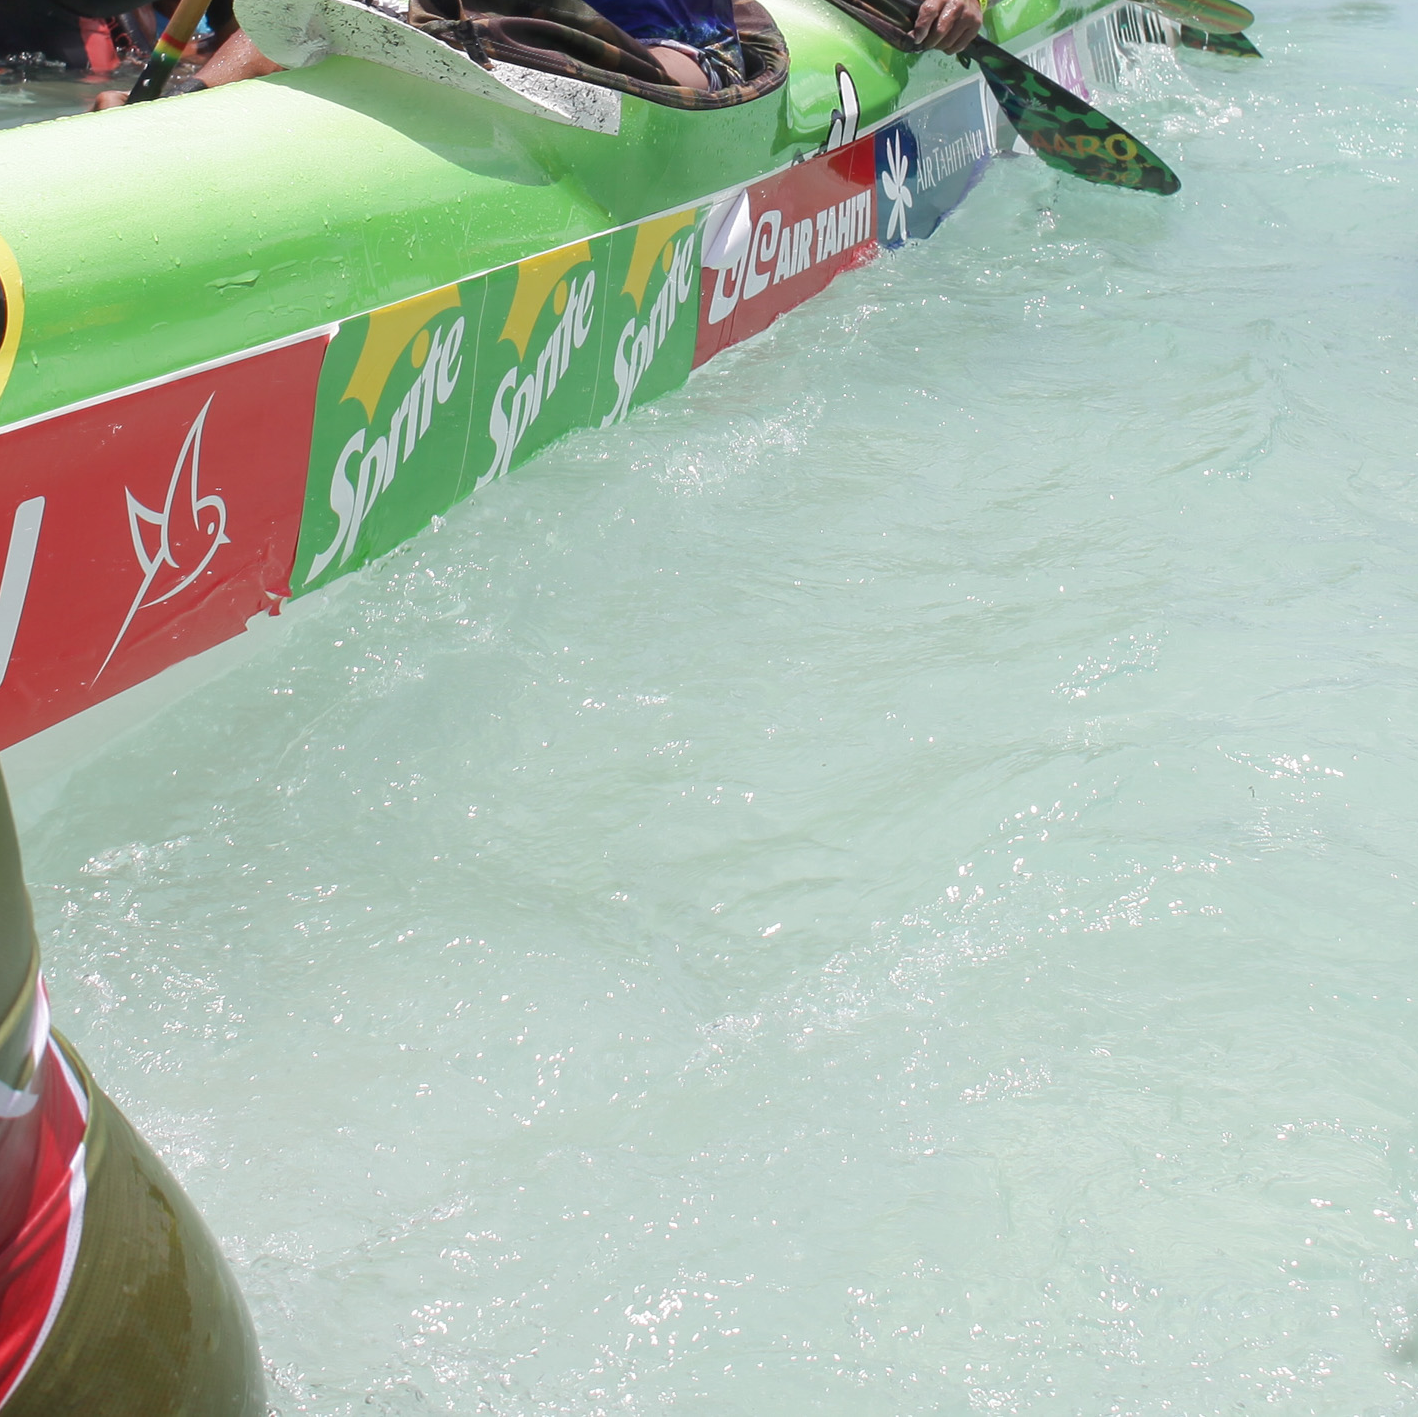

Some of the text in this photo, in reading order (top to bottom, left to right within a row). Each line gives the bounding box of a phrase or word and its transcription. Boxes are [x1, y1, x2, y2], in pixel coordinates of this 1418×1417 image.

[773, 189, 872, 286] AIR TAHITI
[916, 128, 985, 194] AIR TAHITI NUI
[475, 269, 595, 492] Sprite
[600, 230, 695, 428] Sprite
[304, 316, 466, 584] Sprite
